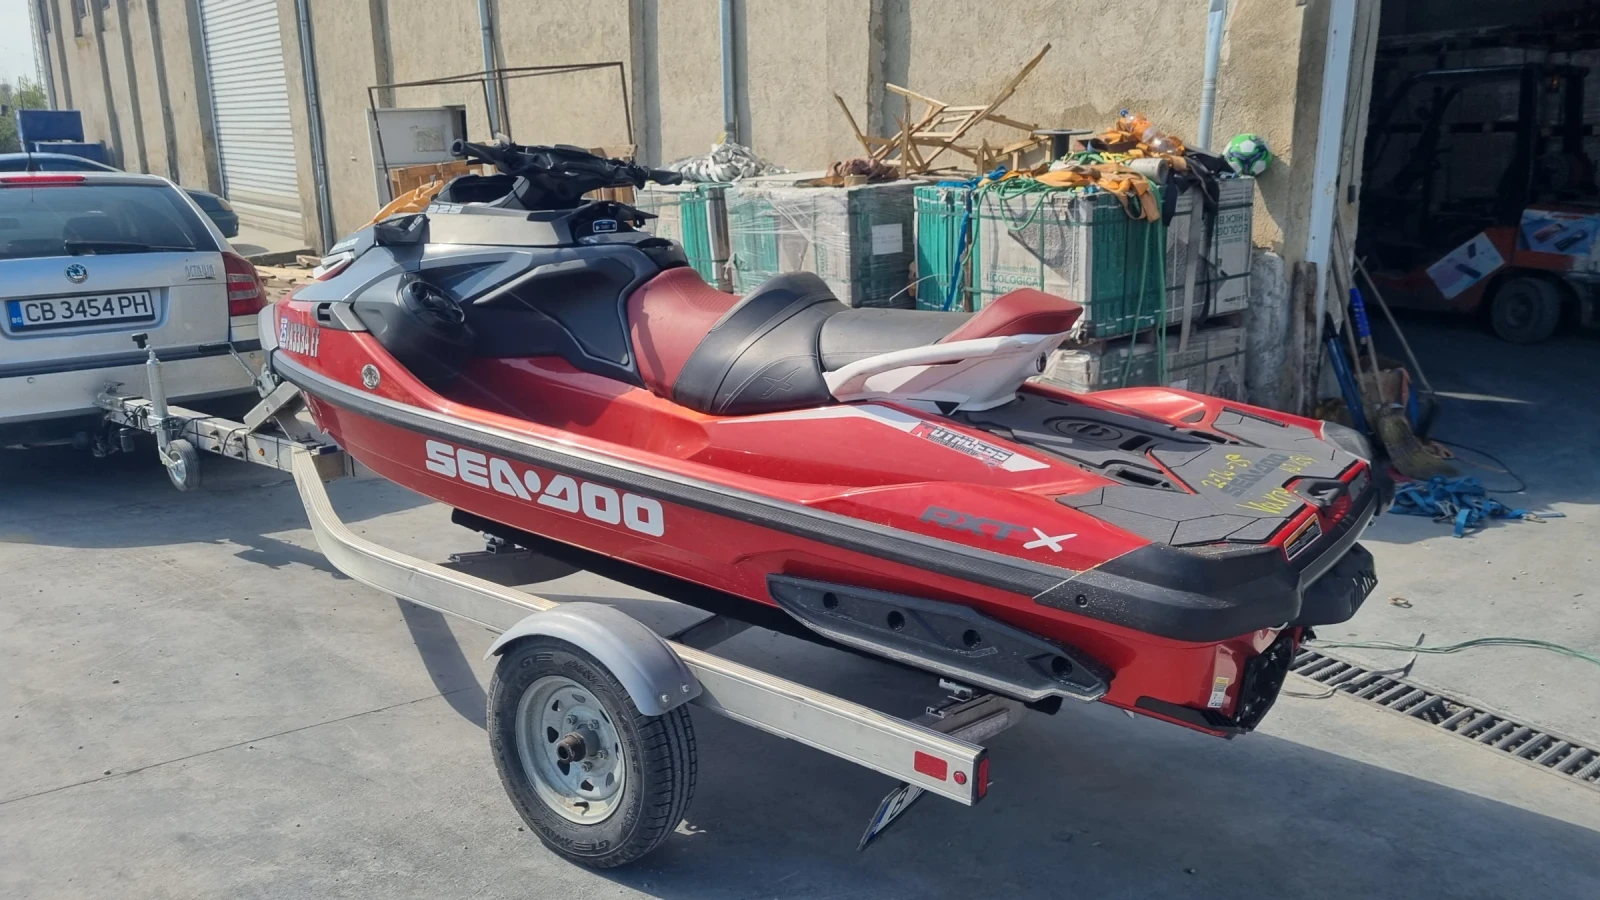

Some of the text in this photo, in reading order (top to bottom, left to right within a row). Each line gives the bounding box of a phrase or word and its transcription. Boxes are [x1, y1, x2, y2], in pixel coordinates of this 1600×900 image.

[25, 294, 148, 322] CB 3454 PH
[919, 505, 1078, 553] RXT X
